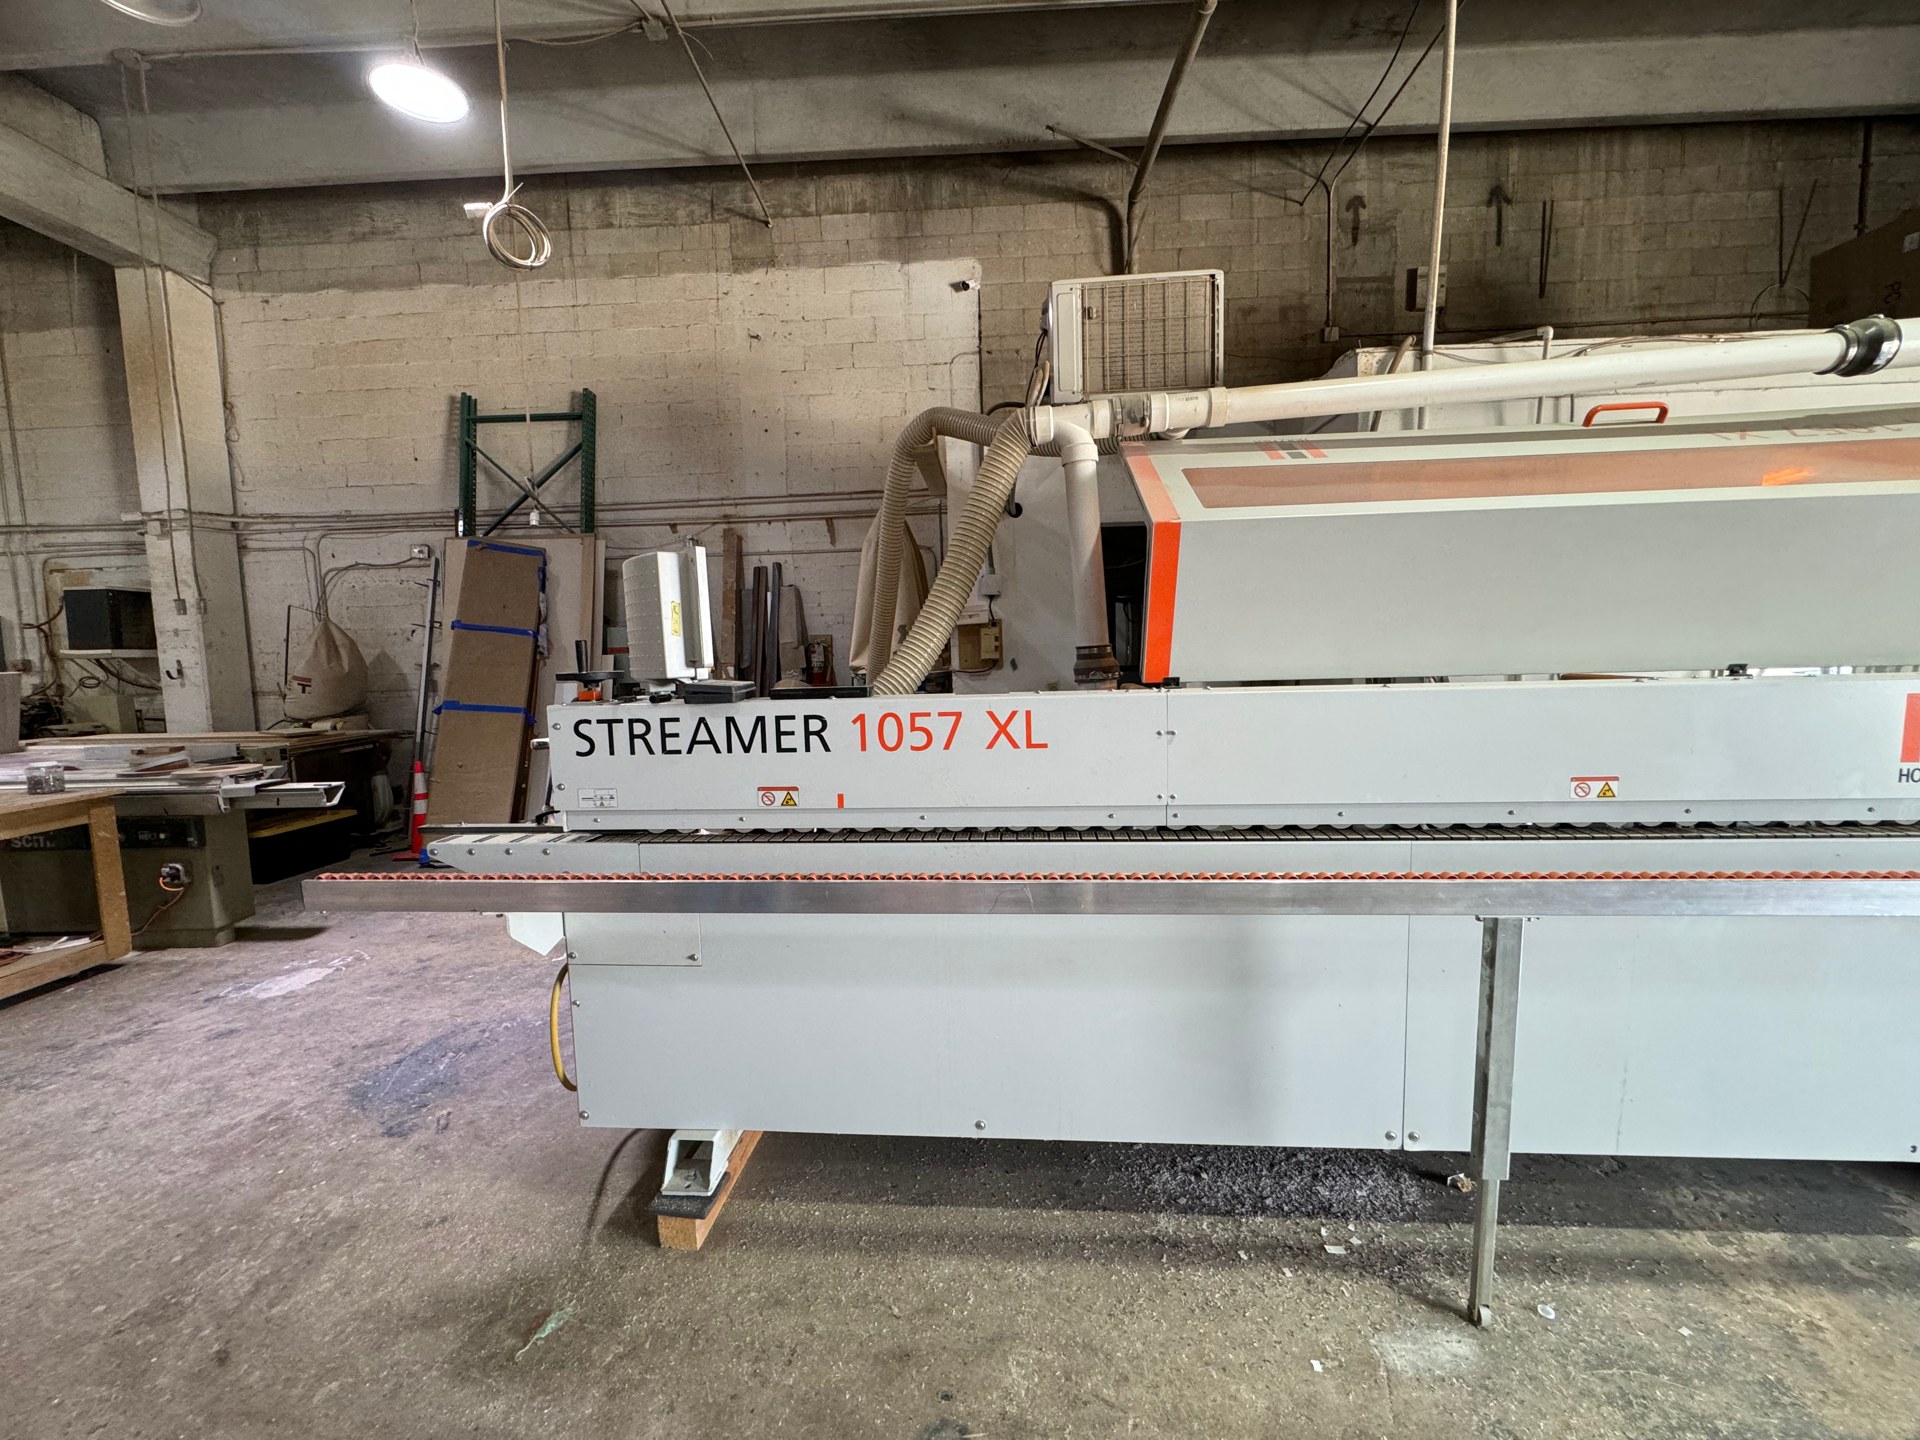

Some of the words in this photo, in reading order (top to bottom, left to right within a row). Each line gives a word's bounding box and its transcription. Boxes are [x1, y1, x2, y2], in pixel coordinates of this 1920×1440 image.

[573, 714, 832, 758] STREAMER
[850, 710, 963, 753] 1057
[985, 709, 1050, 750] XL
